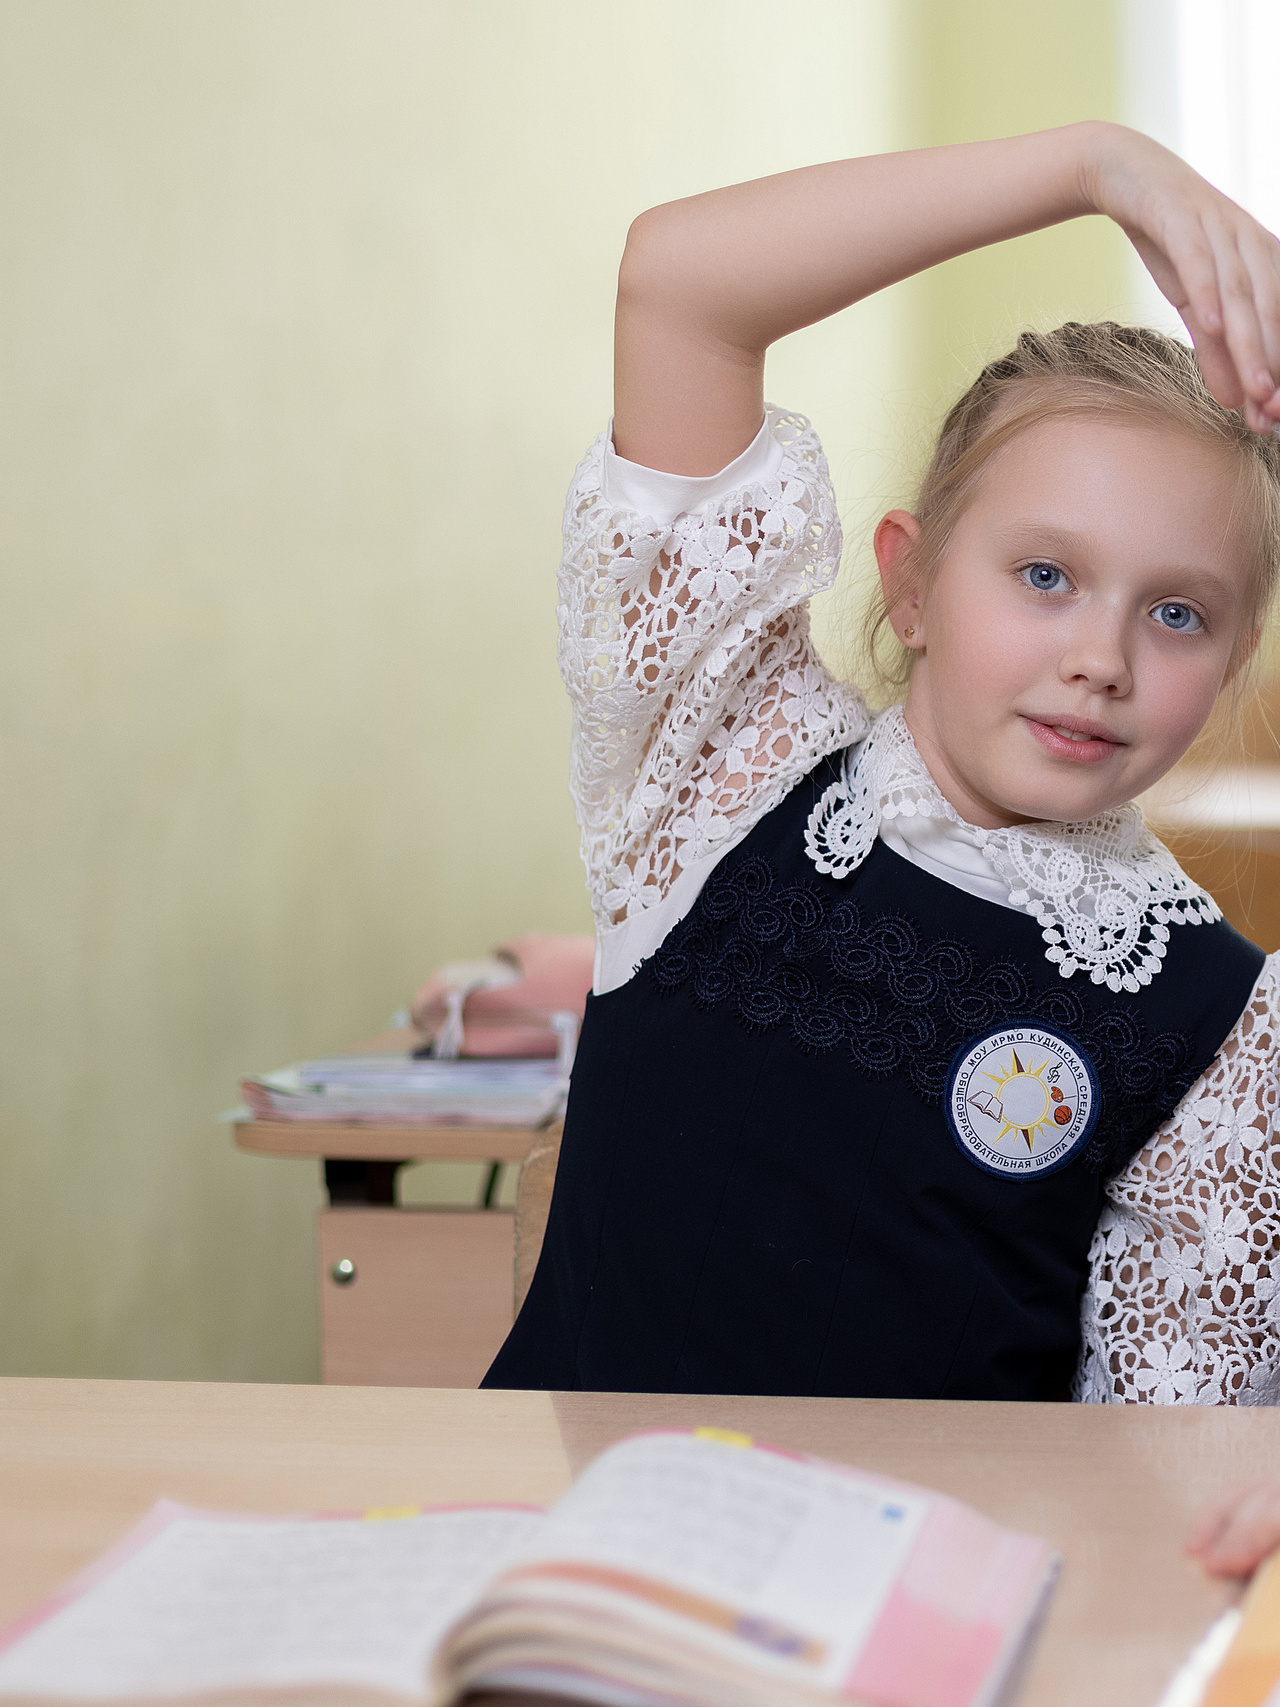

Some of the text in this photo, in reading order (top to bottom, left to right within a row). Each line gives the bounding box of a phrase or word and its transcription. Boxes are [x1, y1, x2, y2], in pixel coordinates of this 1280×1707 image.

[956, 1033, 1087, 1168] МОУ ИРМО КУДИНСКАЯ СРЕДНЯЯ ОБЩЕОБРАЗОВАТЕЛЬНАЯ ШКОЛА
